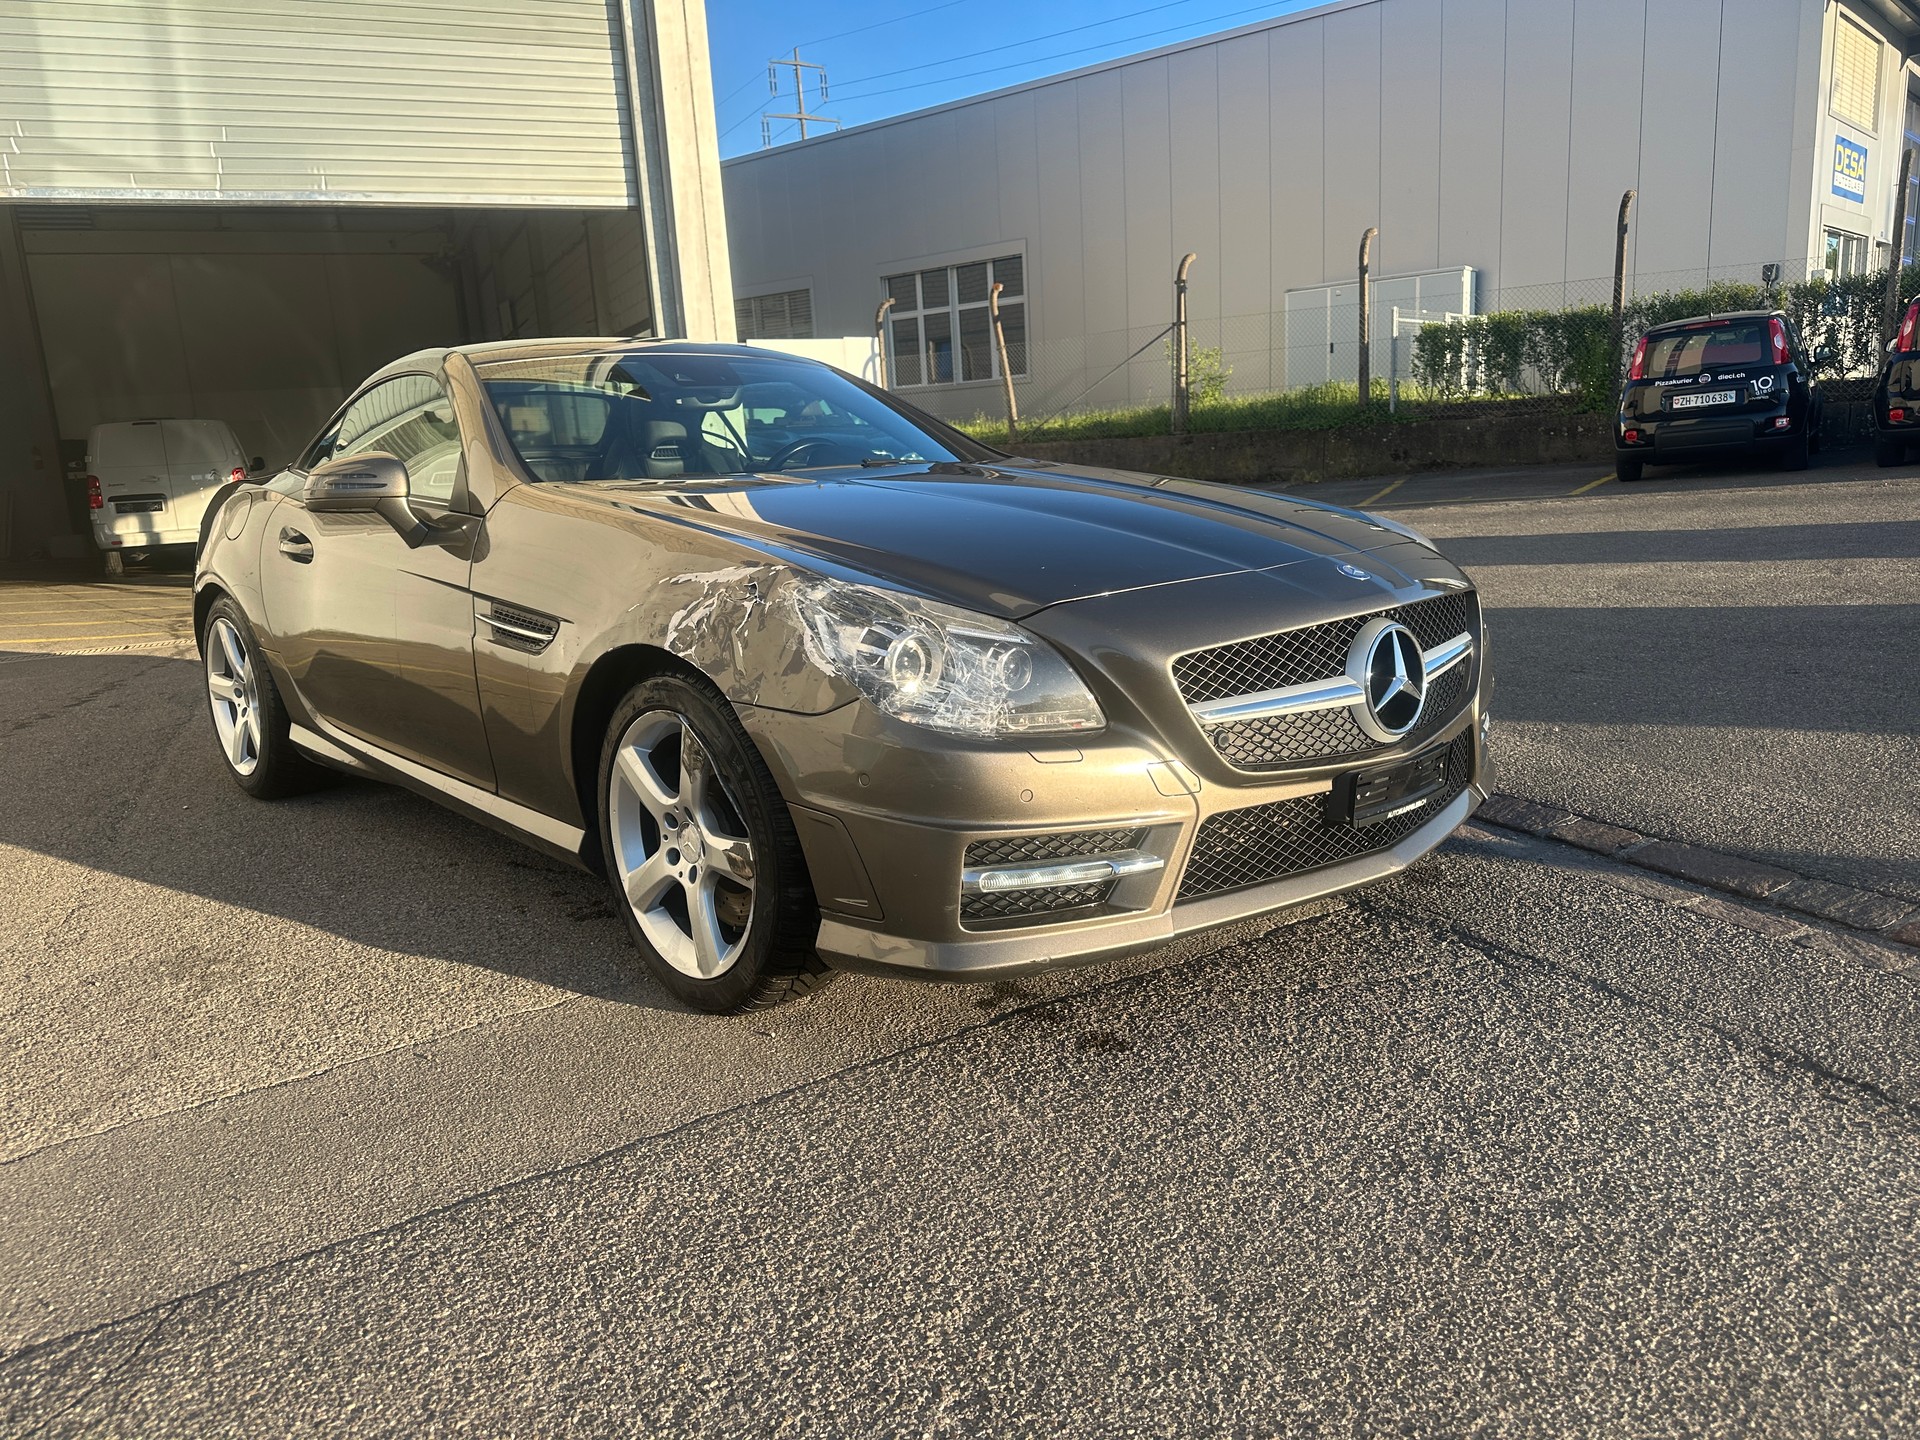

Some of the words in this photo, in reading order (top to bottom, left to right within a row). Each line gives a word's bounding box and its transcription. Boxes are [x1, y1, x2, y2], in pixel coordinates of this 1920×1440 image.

[1835, 145, 1865, 181] DESA
[1655, 378, 1693, 387] Pizzakurier
[1755, 386, 1775, 395] dieci
